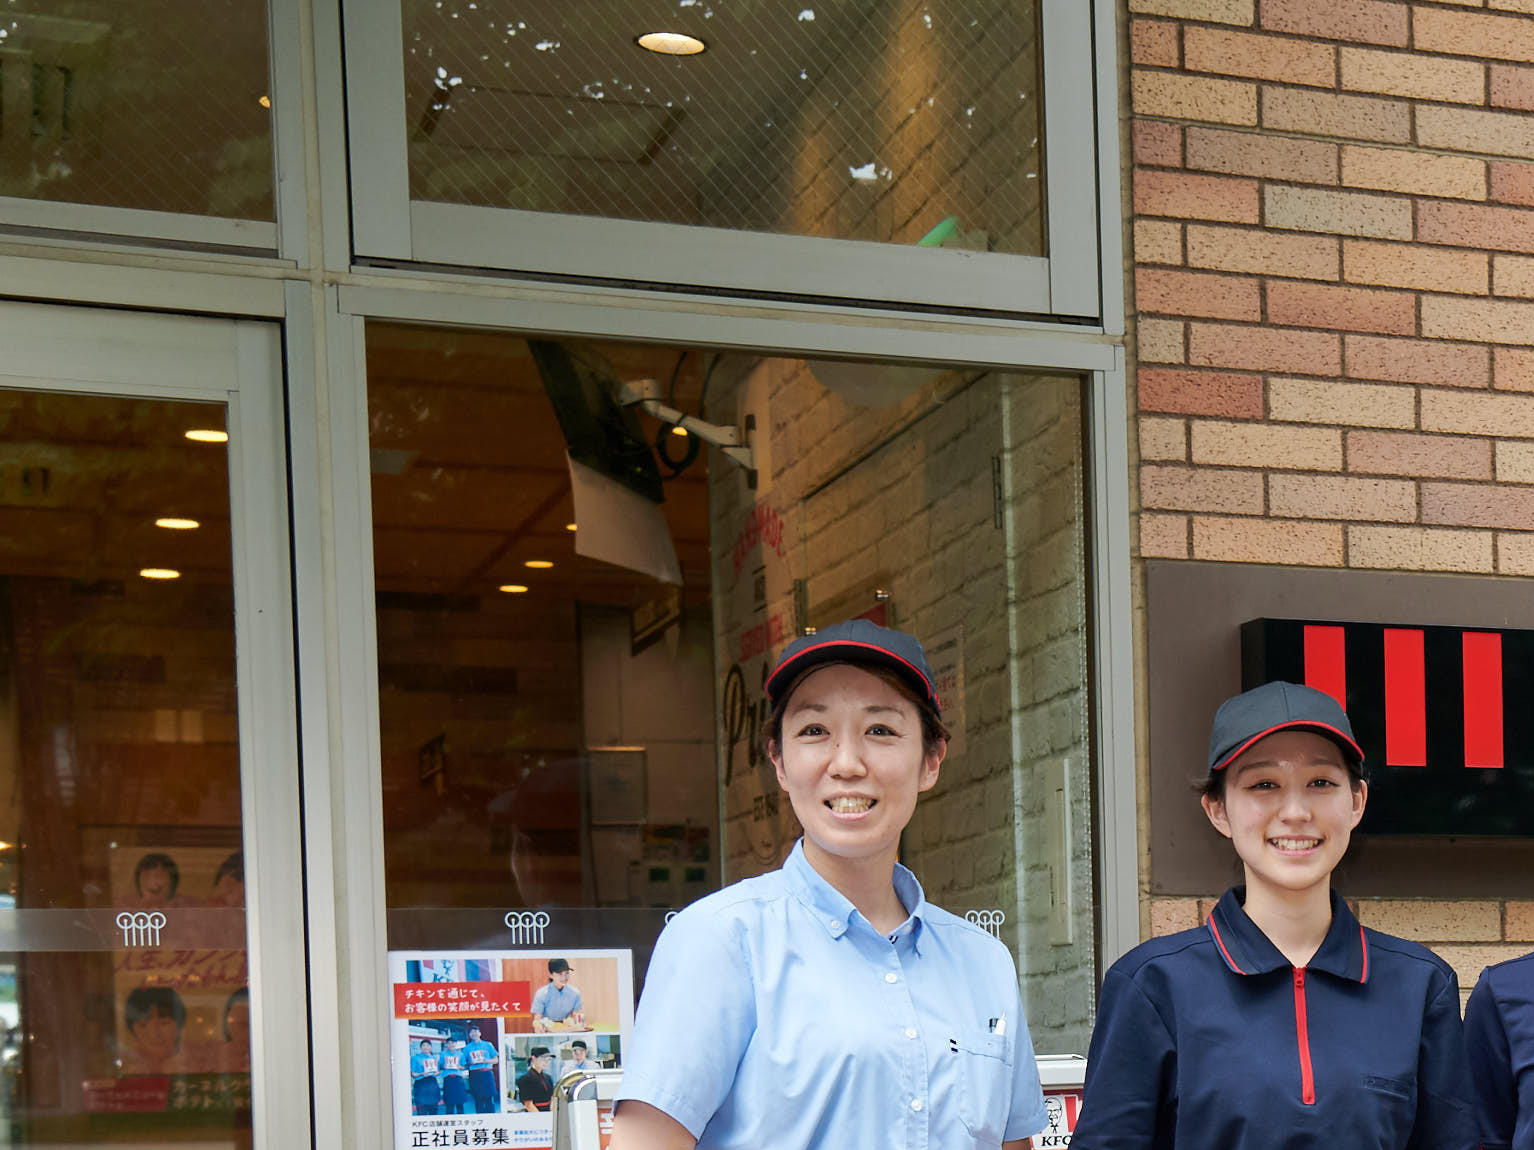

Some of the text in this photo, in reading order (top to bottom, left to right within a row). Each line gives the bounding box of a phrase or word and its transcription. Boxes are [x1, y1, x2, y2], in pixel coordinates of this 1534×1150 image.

[404, 988, 485, 999] チキンを通じて、
[404, 1002, 521, 1014] お客様の笑顔が見たくて
[412, 1128, 510, 1148] 正社員募集
